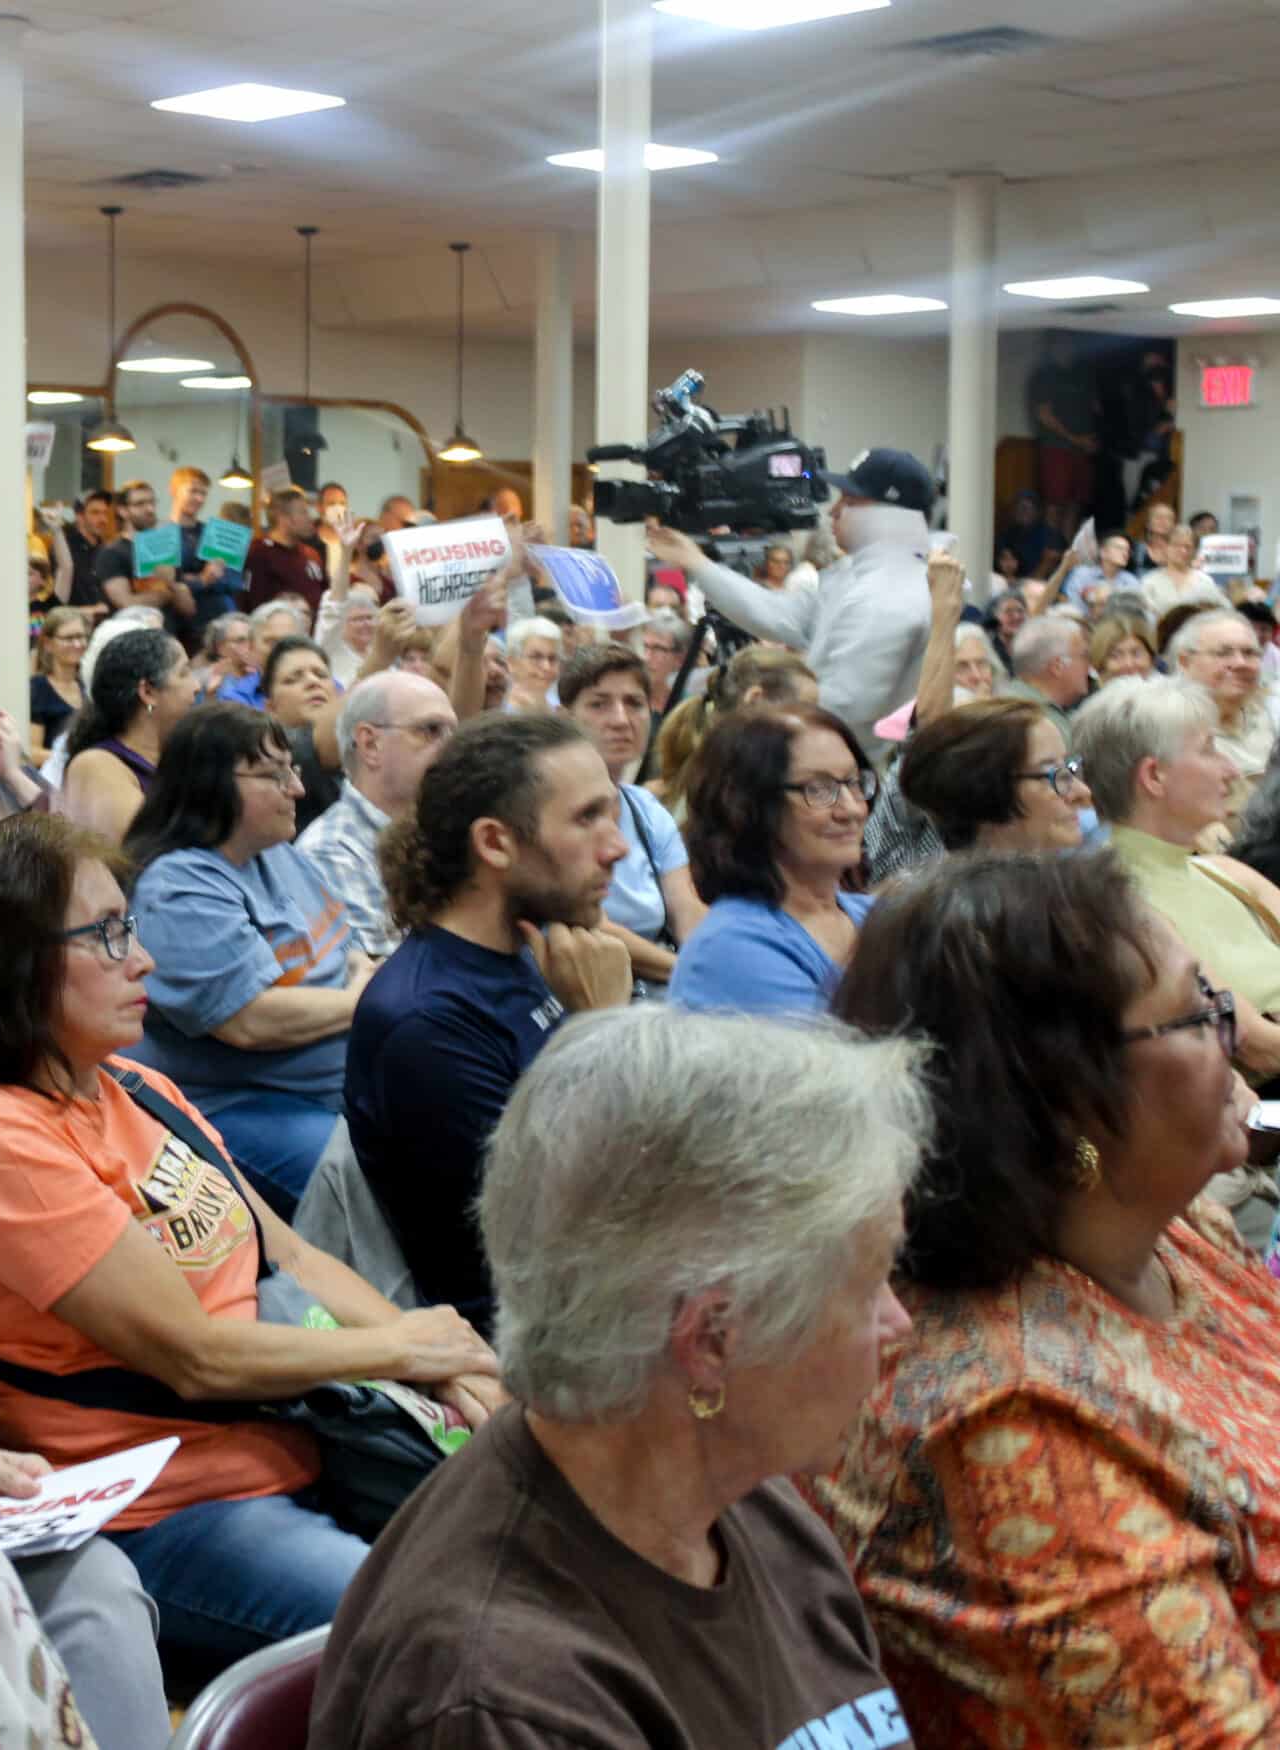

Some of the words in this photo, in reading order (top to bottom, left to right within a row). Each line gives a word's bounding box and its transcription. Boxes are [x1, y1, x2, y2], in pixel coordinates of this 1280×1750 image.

[1203, 366, 1253, 406] EXIT
[403, 538, 507, 567] HOUSING
[418, 568, 498, 605] HIGHRIS
